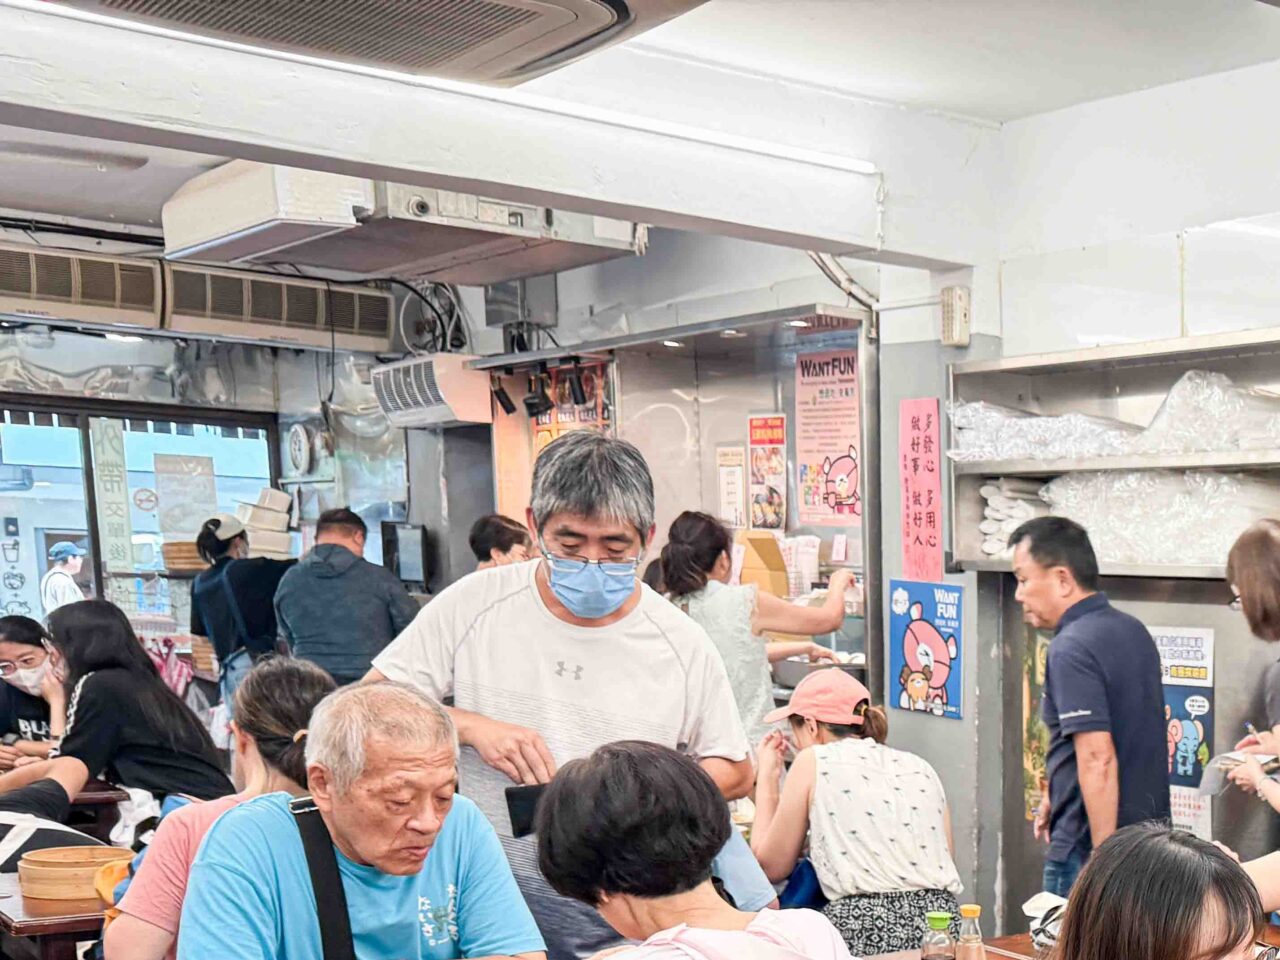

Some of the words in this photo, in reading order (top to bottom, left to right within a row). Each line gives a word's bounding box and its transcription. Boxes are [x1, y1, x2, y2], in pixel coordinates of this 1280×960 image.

[934, 588, 960, 604] WANT
[937, 603, 957, 619] FUN
[18, 718, 50, 735] BLA
